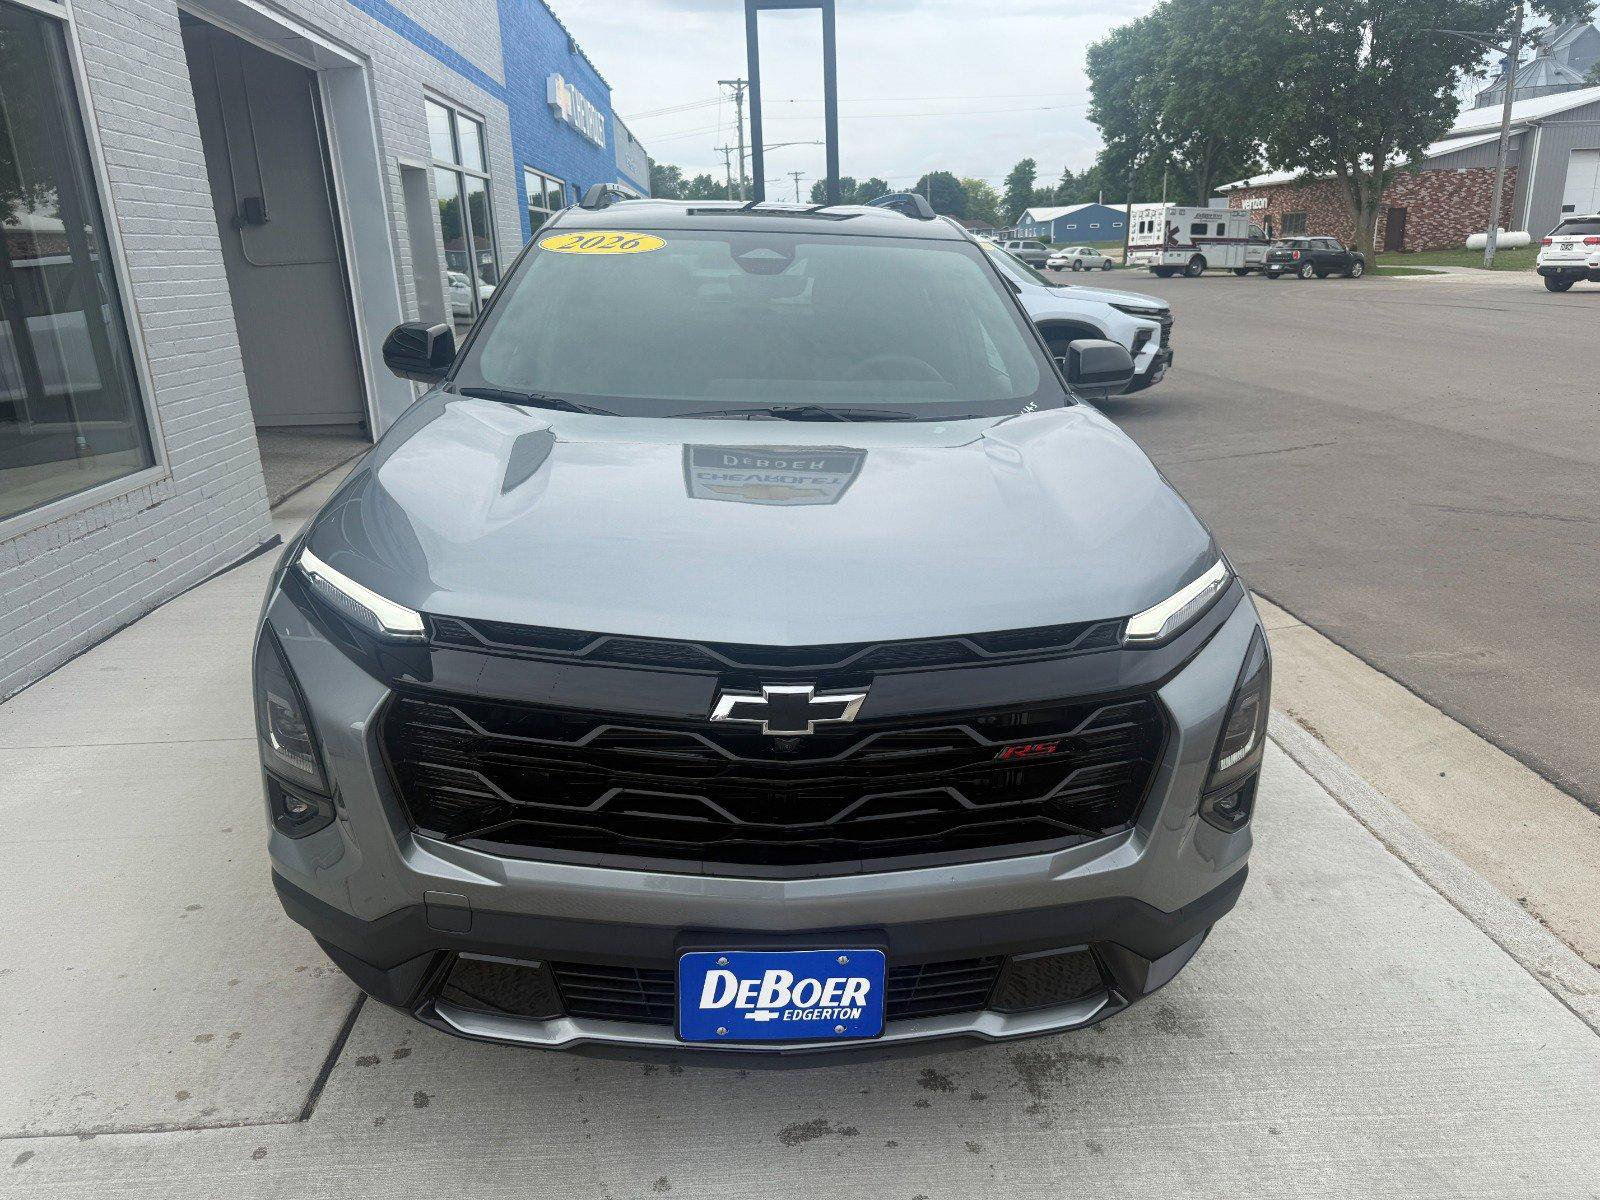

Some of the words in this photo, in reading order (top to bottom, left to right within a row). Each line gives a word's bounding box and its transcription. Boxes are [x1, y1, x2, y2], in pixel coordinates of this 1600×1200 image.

[1242, 196, 1268, 210] verizon
[556, 235, 645, 250] 2026
[995, 742, 1059, 760] RS
[783, 1008, 862, 1021] EDGERTON
